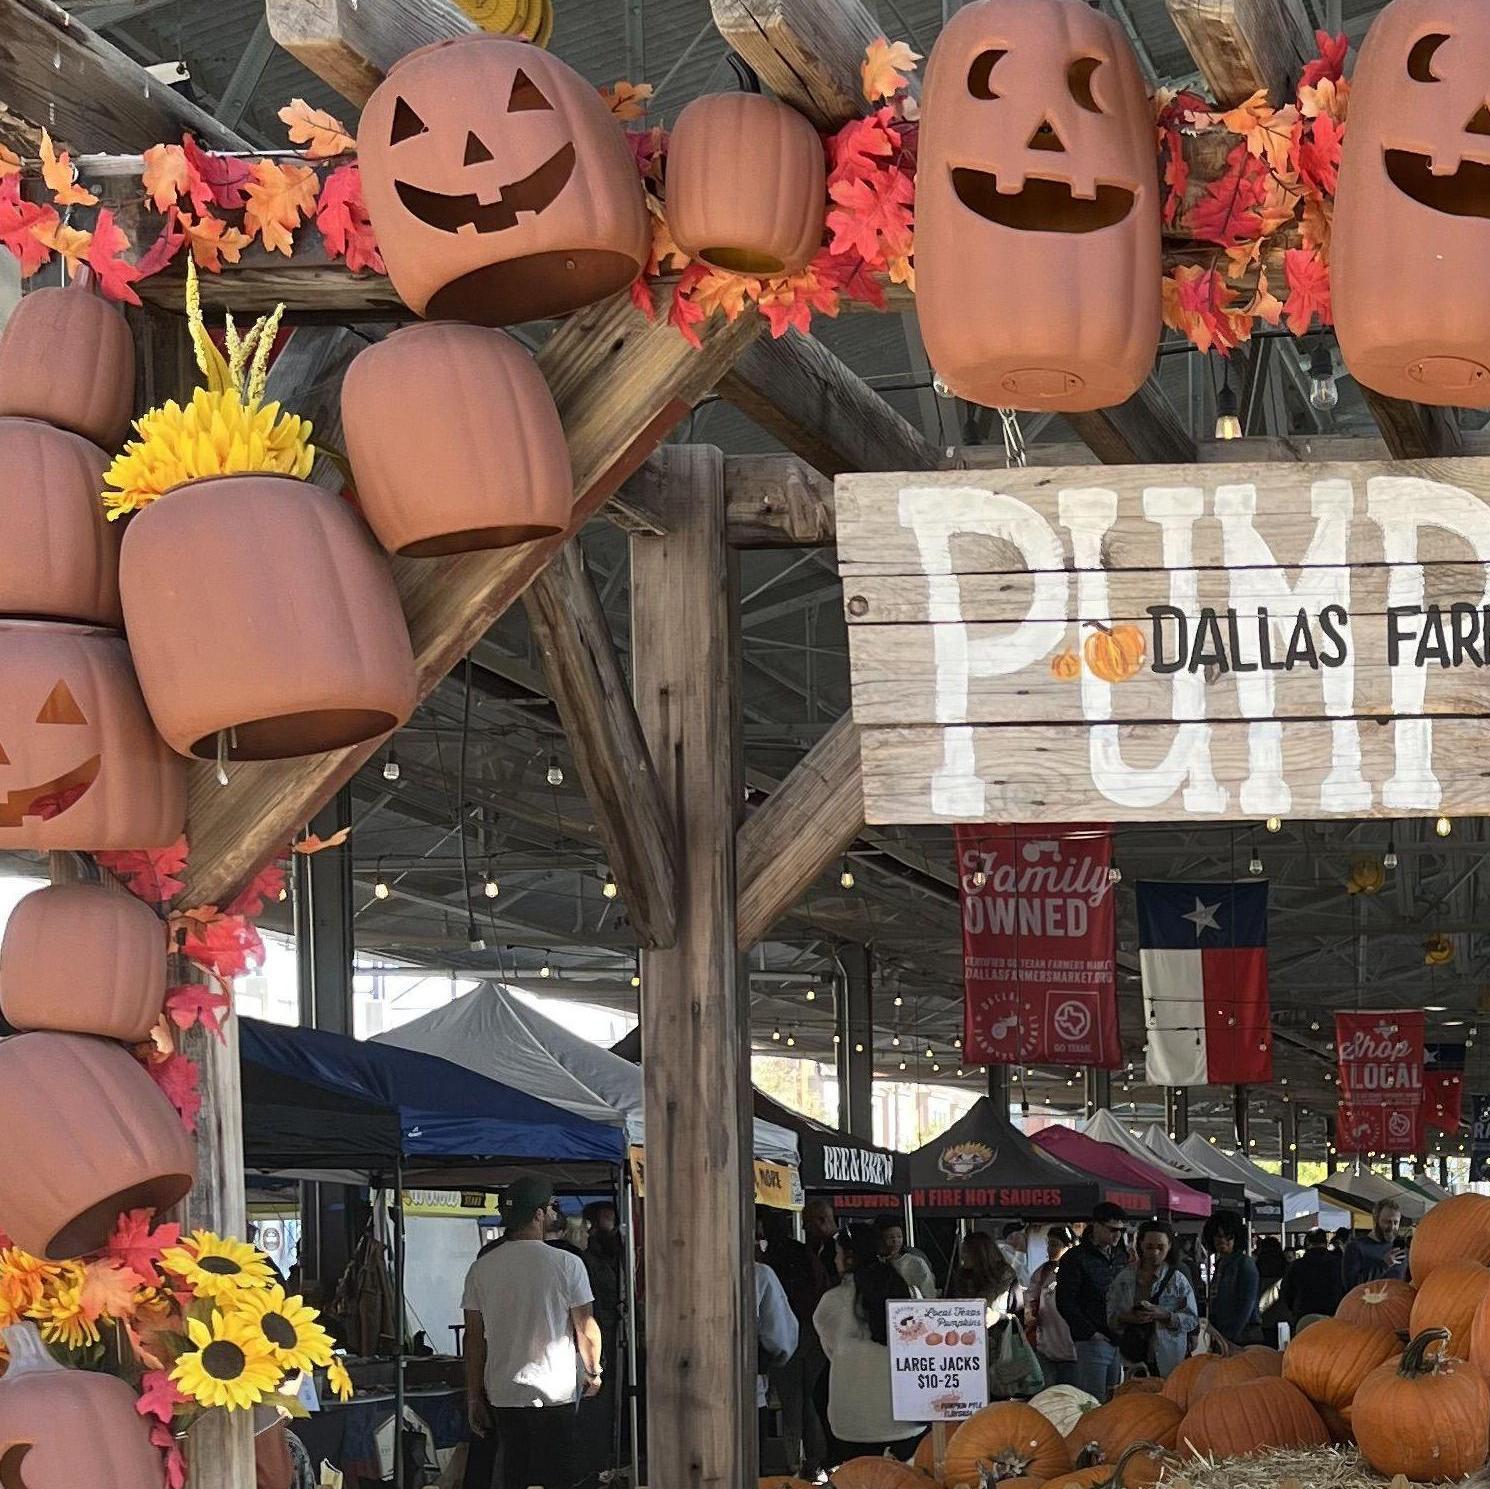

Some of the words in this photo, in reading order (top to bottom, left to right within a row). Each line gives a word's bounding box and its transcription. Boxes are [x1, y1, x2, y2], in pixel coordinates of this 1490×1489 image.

[1145, 604, 1348, 674] DALLAS
[962, 850, 1113, 907] Family
[965, 896, 1088, 937] OWNED
[1341, 1031, 1412, 1061] Shop
[1350, 1063, 1422, 1089] LOCAL
[930, 1189, 961, 1207] FIRE
[965, 1189, 996, 1207] HOT
[1000, 1188, 1061, 1206] SAUCES
[896, 1357, 935, 1371] LARGE
[940, 1357, 980, 1371] JACKS
[918, 1374, 960, 1389] $10-25
